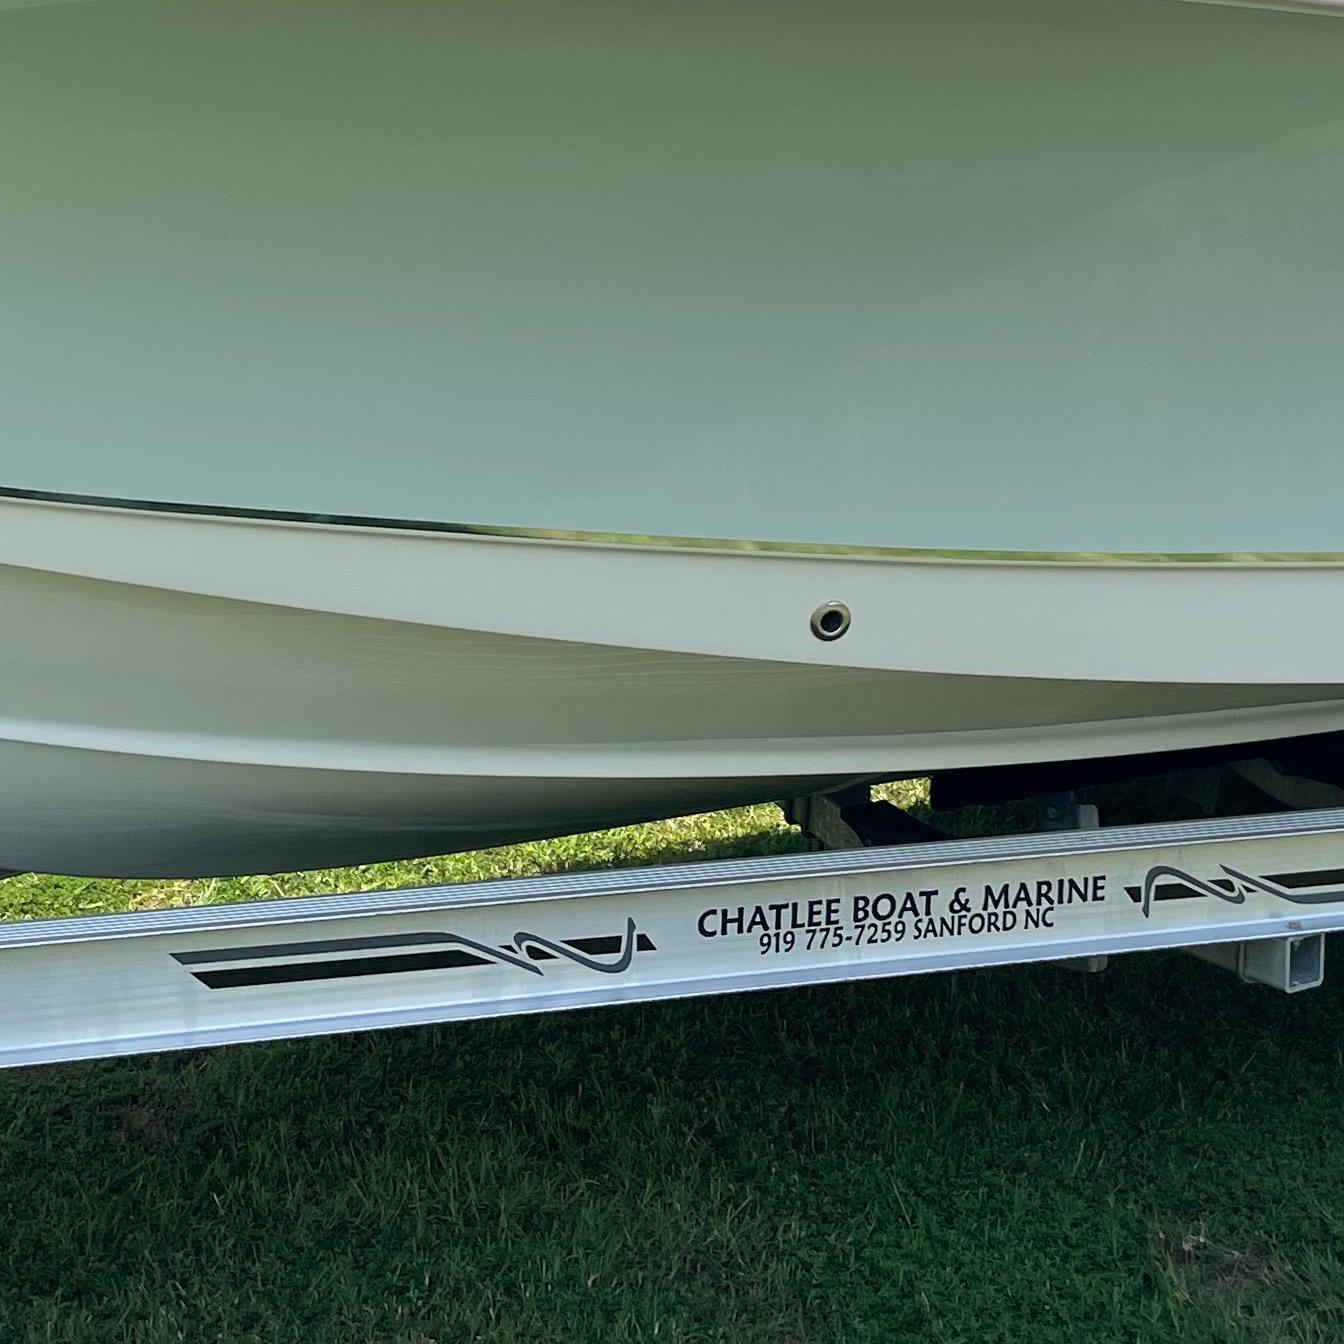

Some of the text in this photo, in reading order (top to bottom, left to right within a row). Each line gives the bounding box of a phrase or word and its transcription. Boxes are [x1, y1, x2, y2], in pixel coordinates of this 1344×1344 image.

[697, 875, 1107, 938] CHATLEE BOAT & MARINE
[759, 906, 1055, 955] 919 775-7259 SANFORD NC
